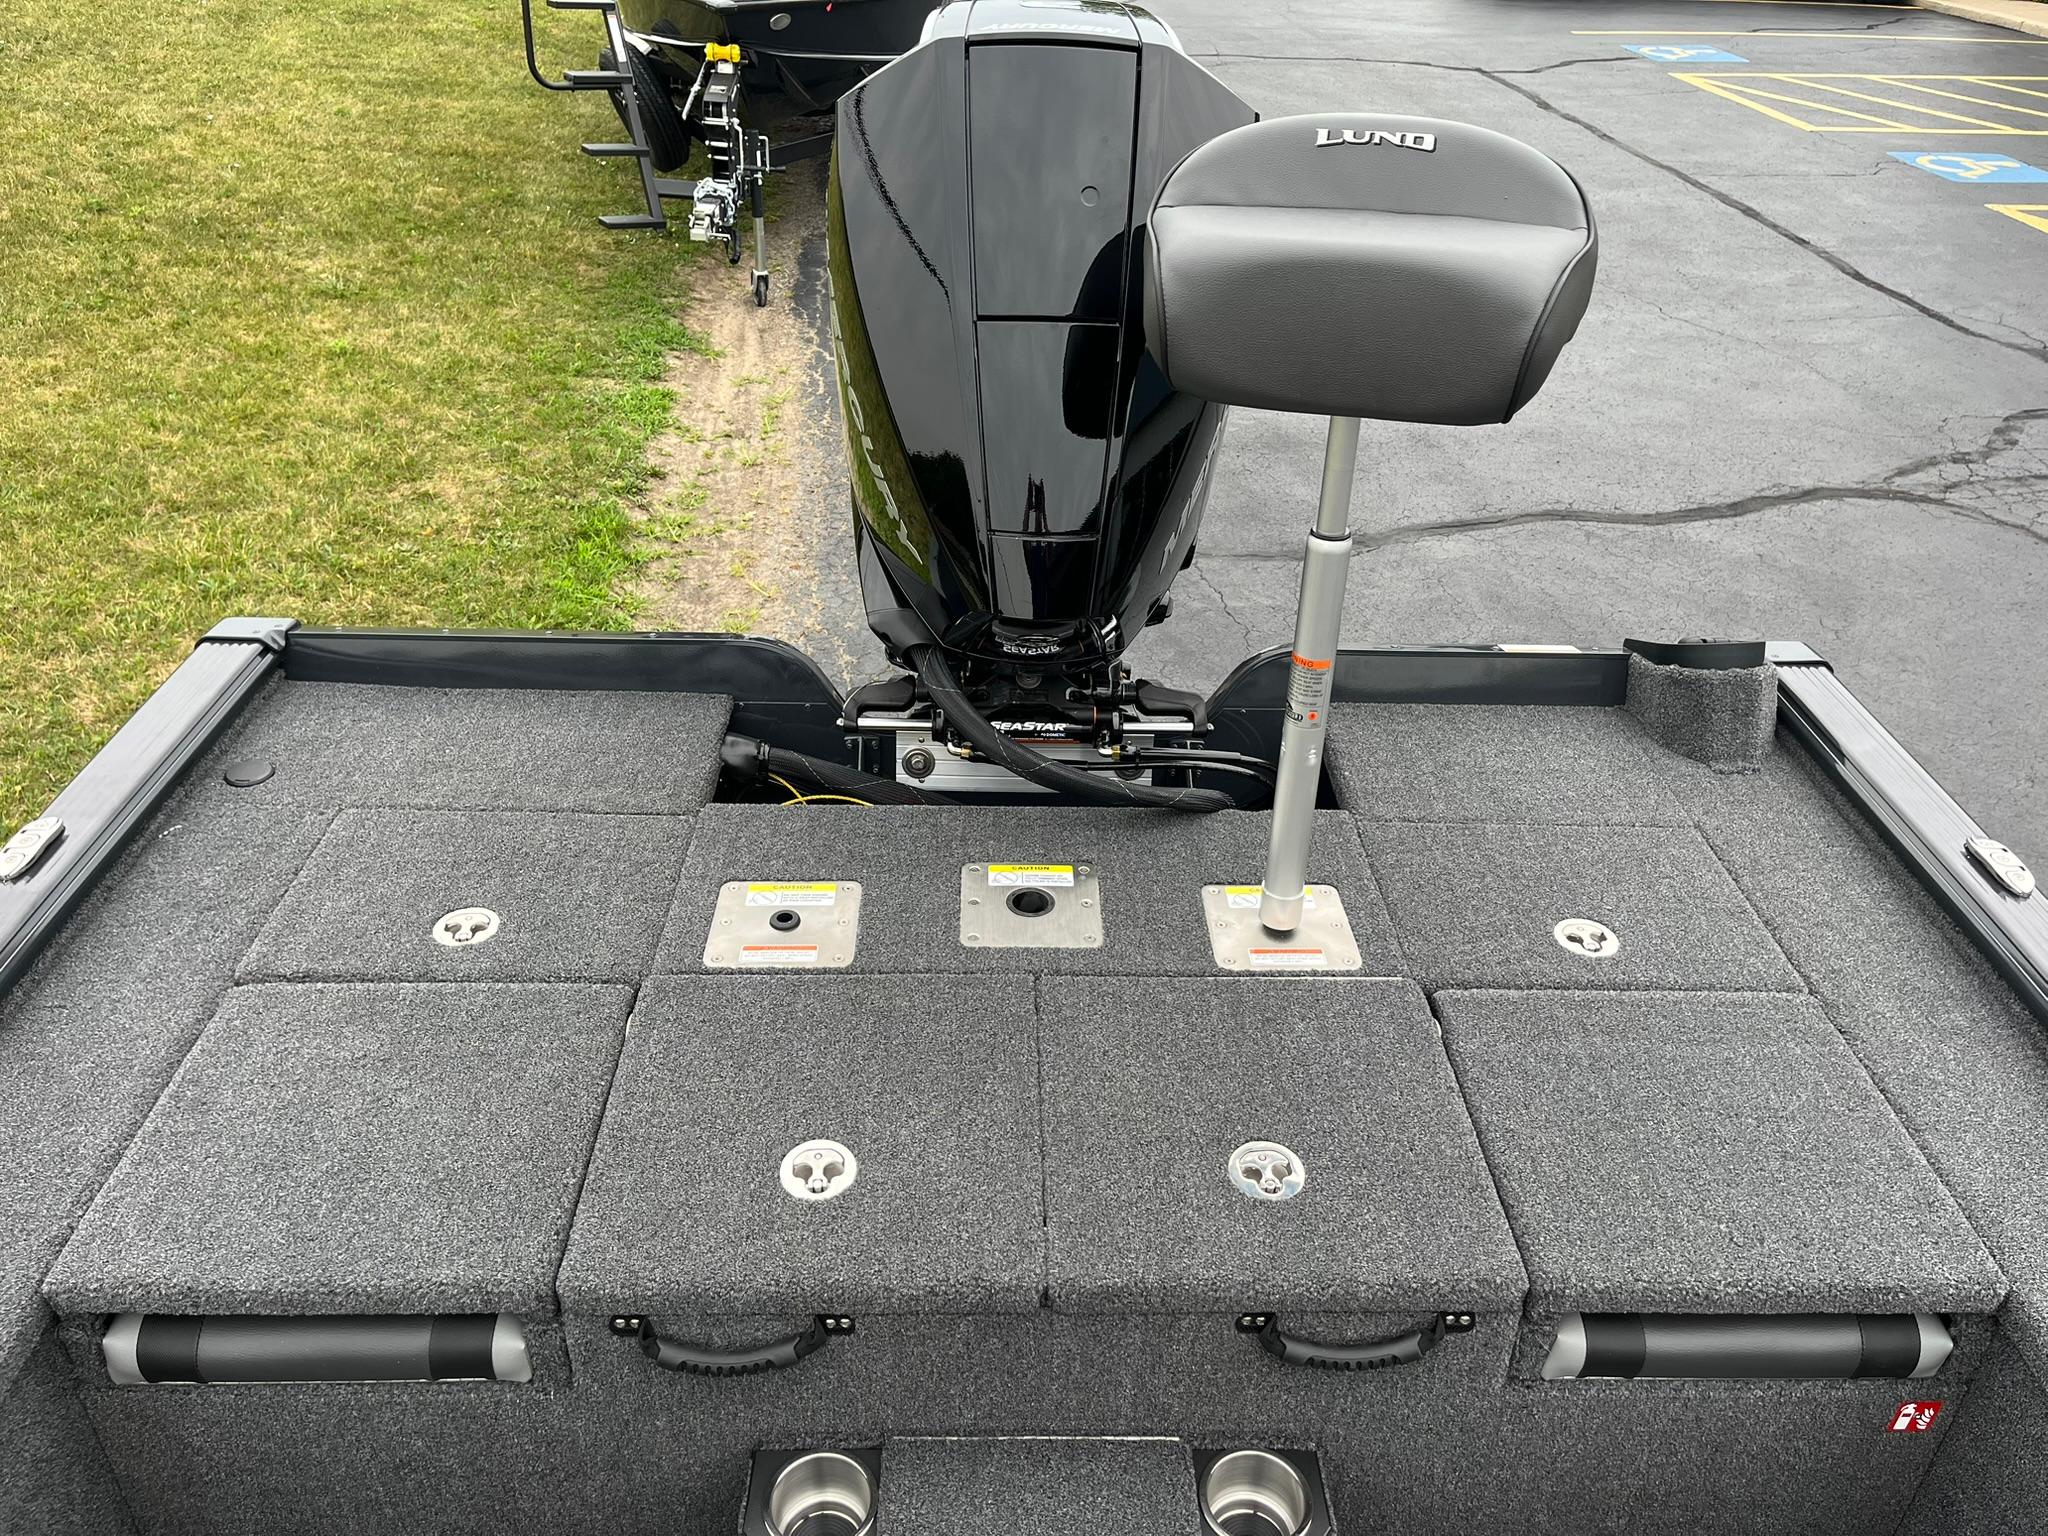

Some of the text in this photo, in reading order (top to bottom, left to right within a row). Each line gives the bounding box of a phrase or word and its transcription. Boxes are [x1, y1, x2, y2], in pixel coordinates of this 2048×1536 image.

[979, 22, 1121, 33] MERCURY
[1315, 128, 1436, 152] LUND
[827, 238, 923, 565] ERCURY
